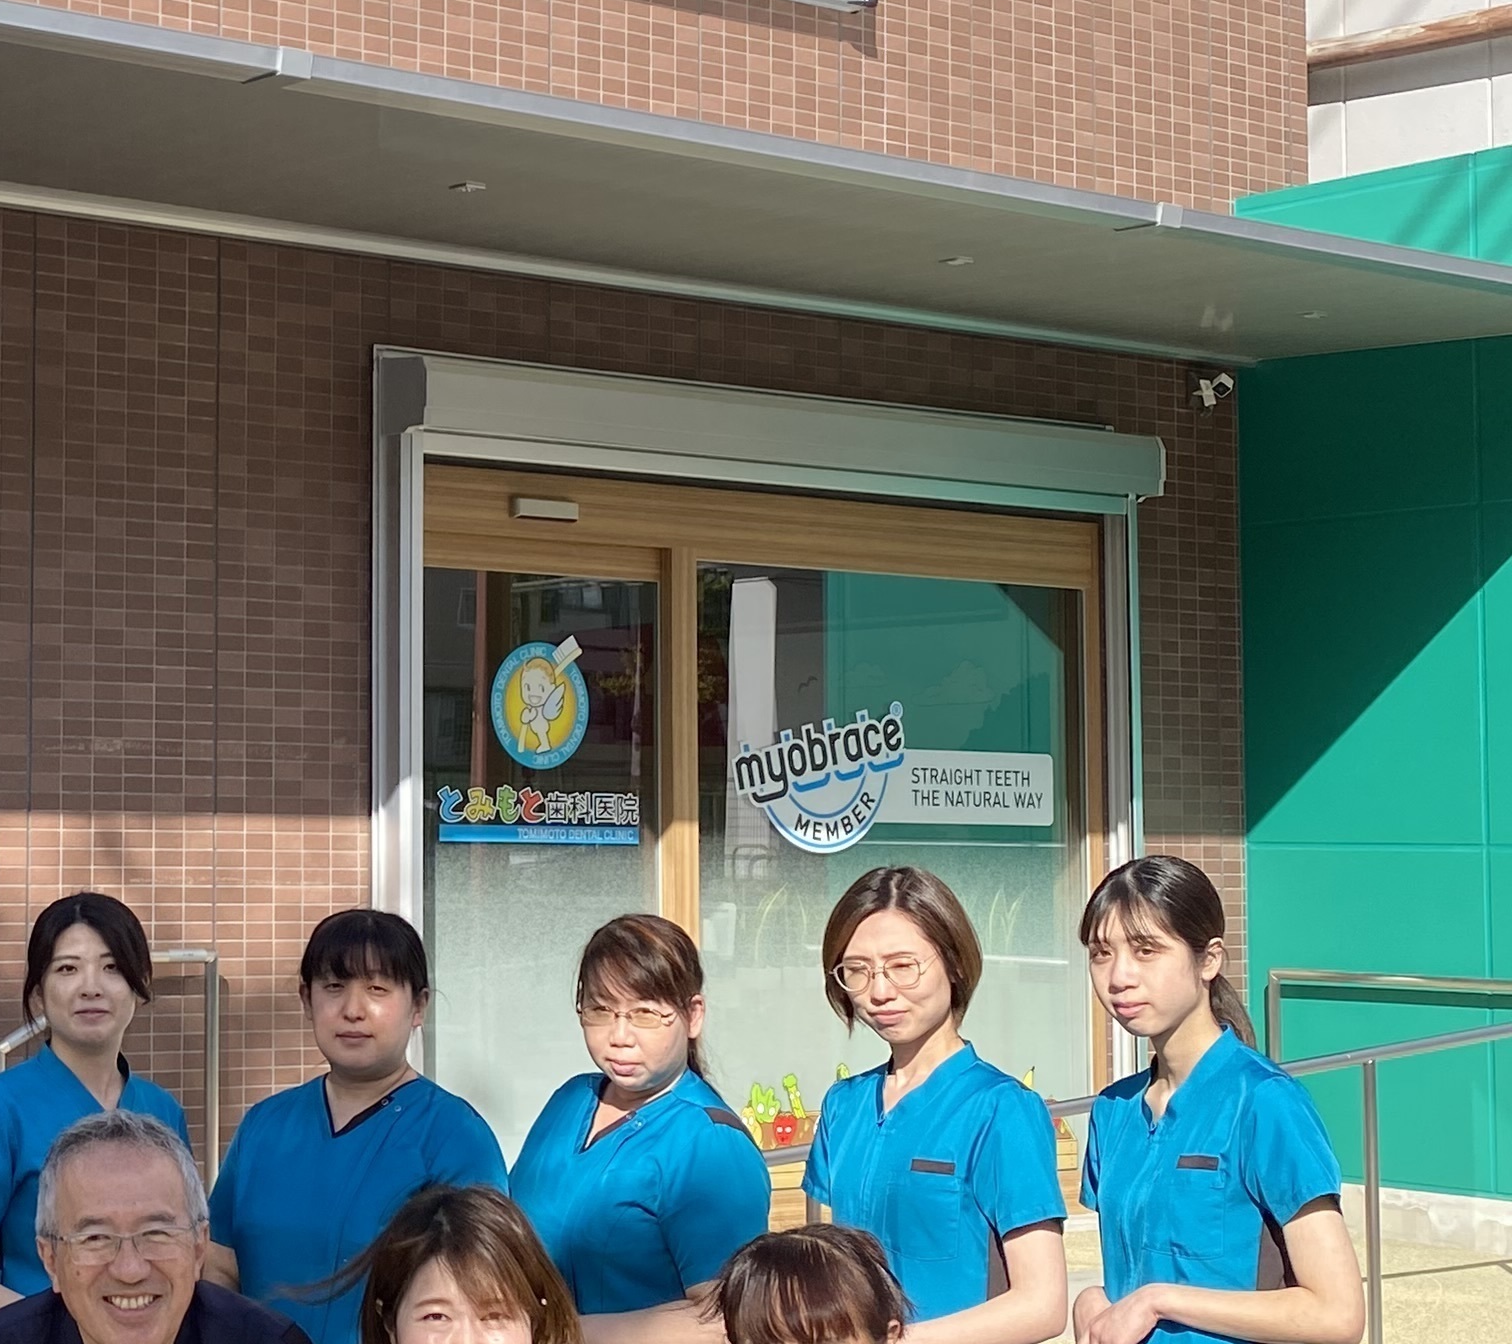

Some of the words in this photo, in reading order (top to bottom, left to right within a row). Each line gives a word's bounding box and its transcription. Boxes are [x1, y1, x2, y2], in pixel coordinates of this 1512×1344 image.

[911, 767, 982, 787] STRAIGHT
[986, 769, 1031, 788] TEETH
[438, 785, 639, 825] とみもと歯科医院
[911, 789, 940, 806] THE
[945, 791, 1010, 808] NATURAL
[1014, 792, 1044, 809] WAY
[794, 791, 876, 841] MEMBER
[517, 828, 566, 840] TOMIMOTO
[569, 829, 603, 840] DENTAL
[604, 830, 634, 841] CLINIC
